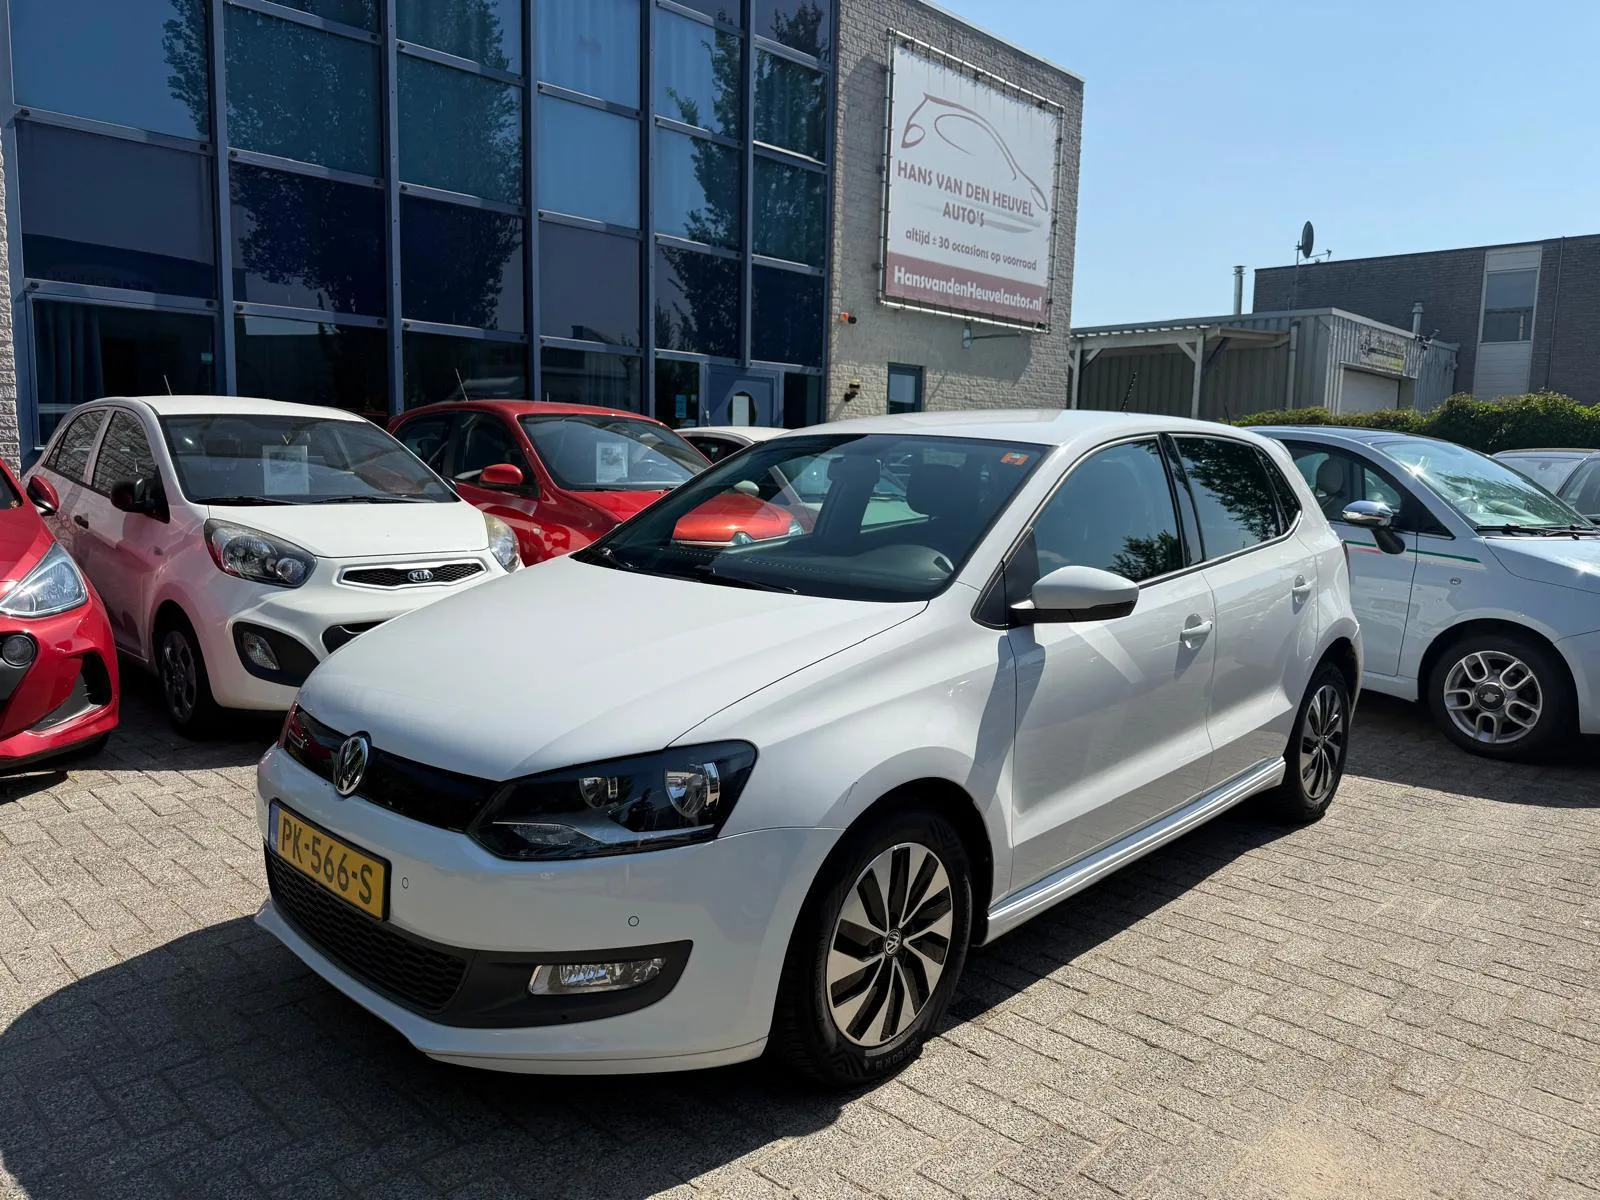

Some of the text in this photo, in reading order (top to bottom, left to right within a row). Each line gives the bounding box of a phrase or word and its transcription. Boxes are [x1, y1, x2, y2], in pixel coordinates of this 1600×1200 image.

[897, 160, 1034, 218] HANS VAN DEN HEUVEL
[942, 201, 984, 227] AUTO'S
[905, 227, 930, 245] altijd
[951, 242, 989, 260] occasions
[990, 251, 1001, 264] op
[1002, 253, 1037, 271] voorraad
[894, 265, 1043, 311] HansvandenHeuvelautos.nl
[410, 570, 431, 581] KIA
[281, 816, 373, 905] PK-566-S
